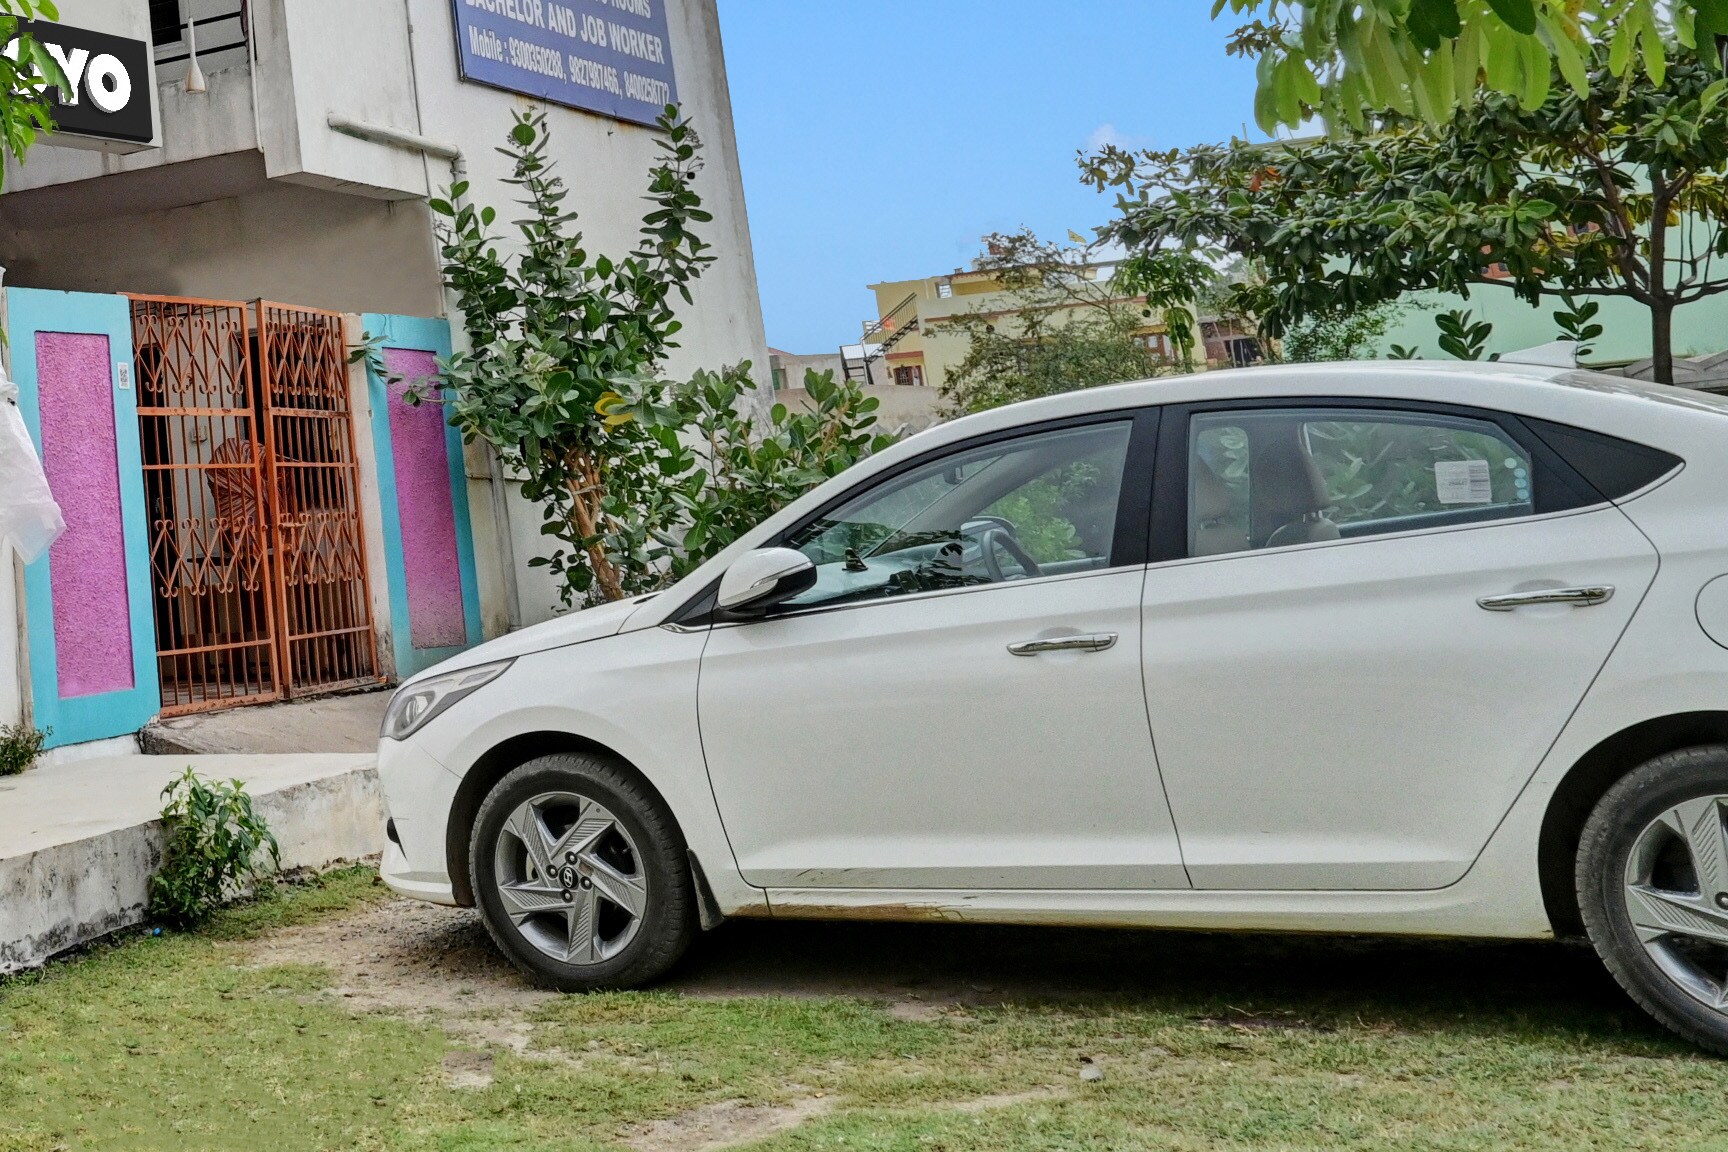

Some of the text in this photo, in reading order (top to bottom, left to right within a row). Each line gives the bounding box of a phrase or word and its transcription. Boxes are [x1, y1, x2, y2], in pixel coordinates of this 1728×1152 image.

[468, 24, 503, 63] Mobile
[548, 2, 577, 38] AND
[580, 13, 608, 48] JOB
[607, 21, 666, 65] WORKER
